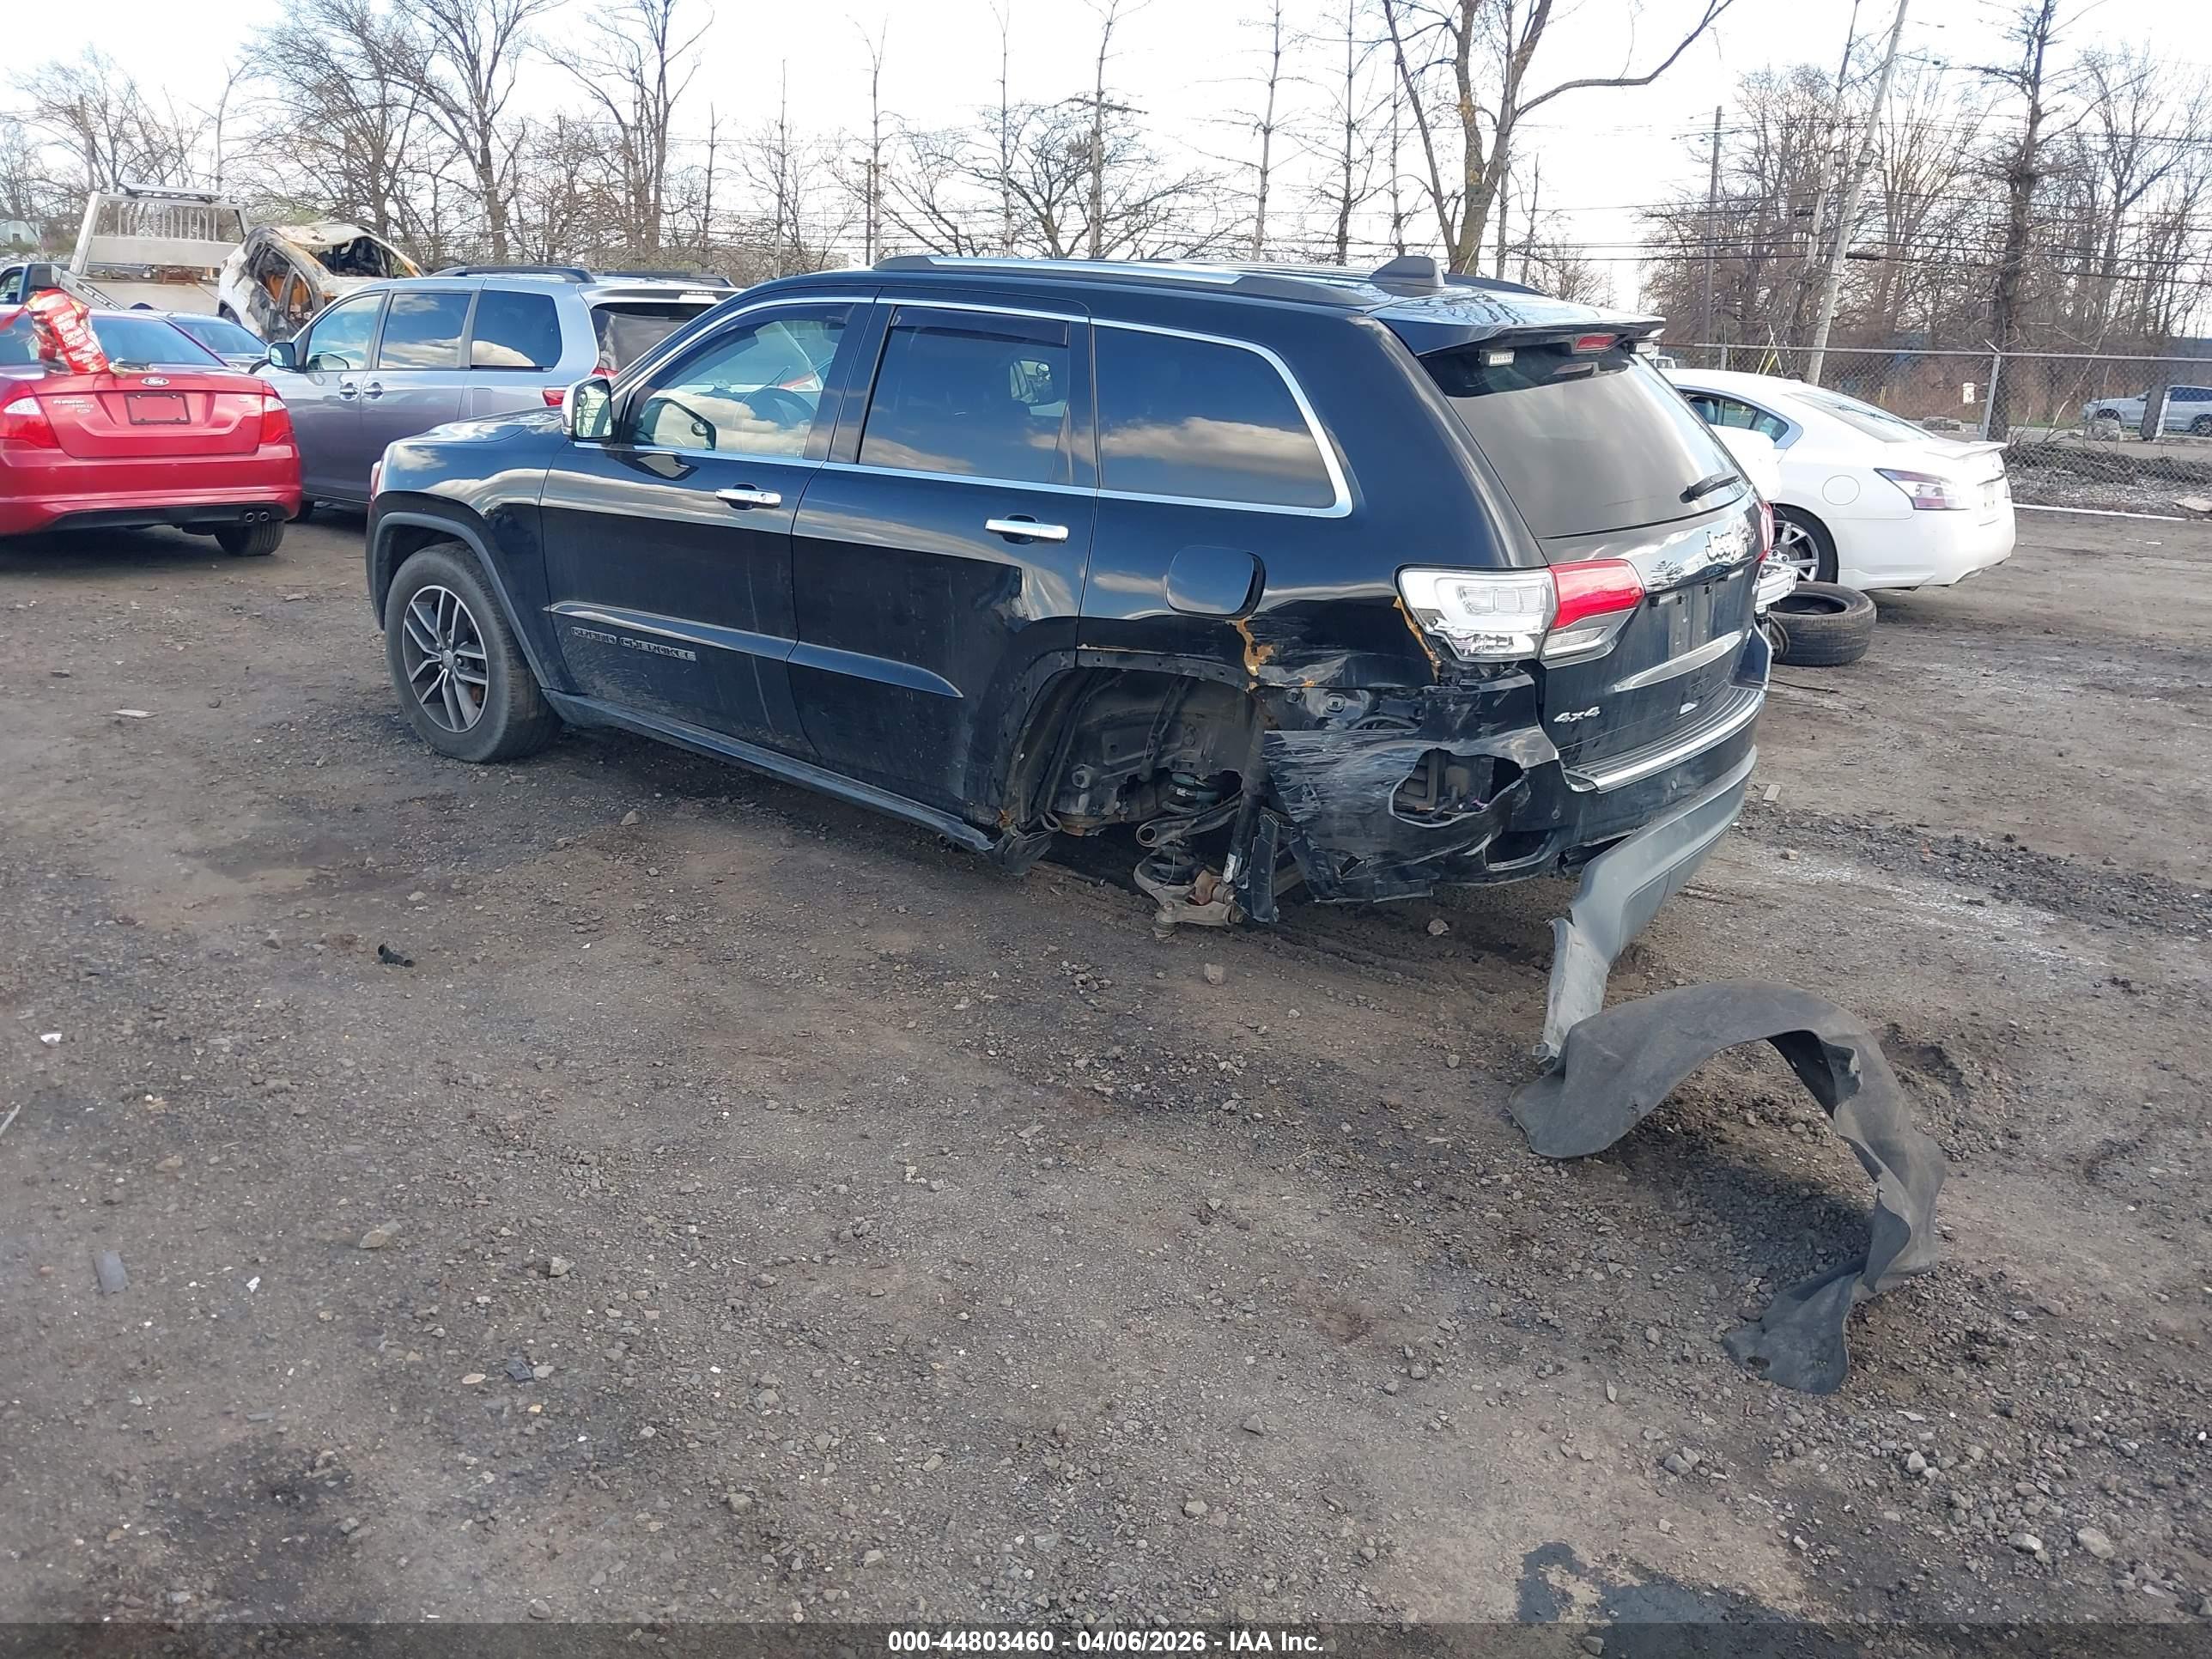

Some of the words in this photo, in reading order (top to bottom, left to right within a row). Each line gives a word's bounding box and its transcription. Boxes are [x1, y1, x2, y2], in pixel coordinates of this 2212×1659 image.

[1705, 530, 1737, 563] Jeep
[570, 626, 617, 645] GRAND
[620, 636, 696, 662] CHEROKEE
[1553, 705, 1601, 723] 4x4
